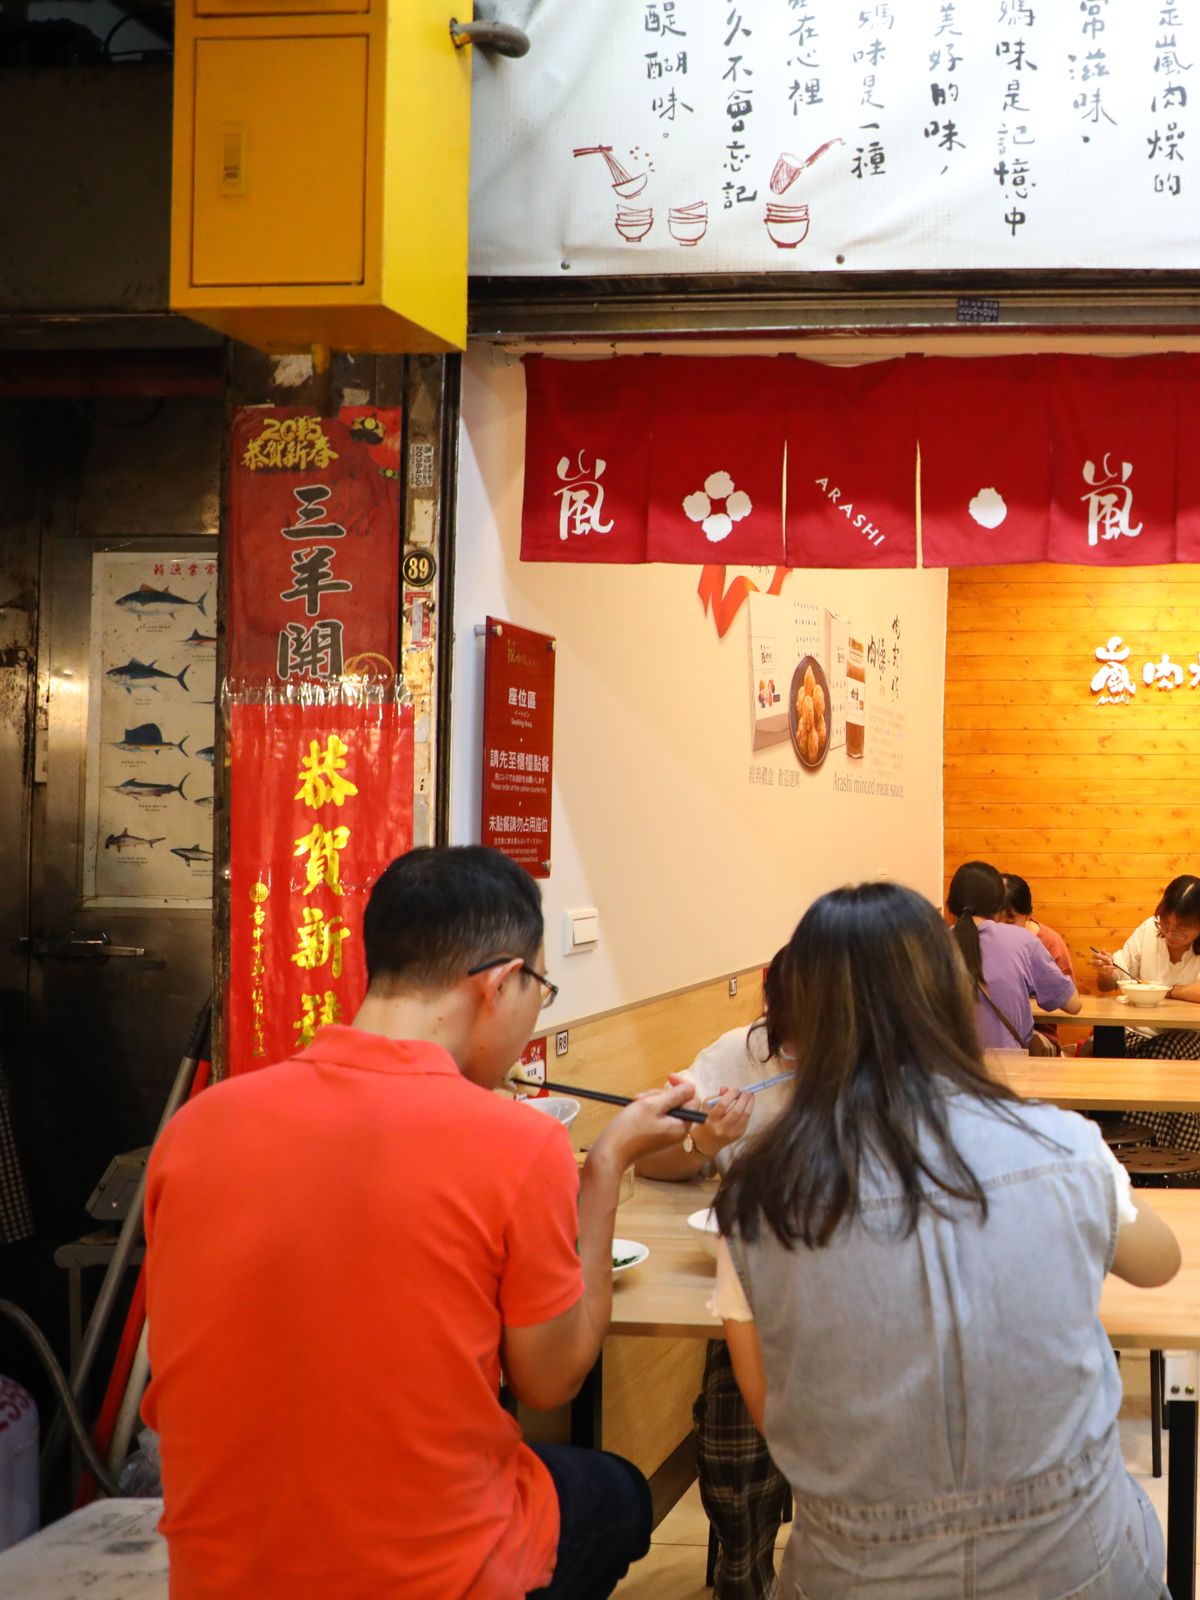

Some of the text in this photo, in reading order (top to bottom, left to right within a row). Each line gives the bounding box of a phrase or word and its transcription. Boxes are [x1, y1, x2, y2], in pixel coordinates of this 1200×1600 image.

[787, 0, 823, 116] 在心裡
[554, 449, 615, 541] 嵐
[815, 476, 886, 547] ARASHI
[1081, 452, 1144, 547] 嵐
[408, 556, 429, 579] 39
[508, 687, 537, 709] 座位區
